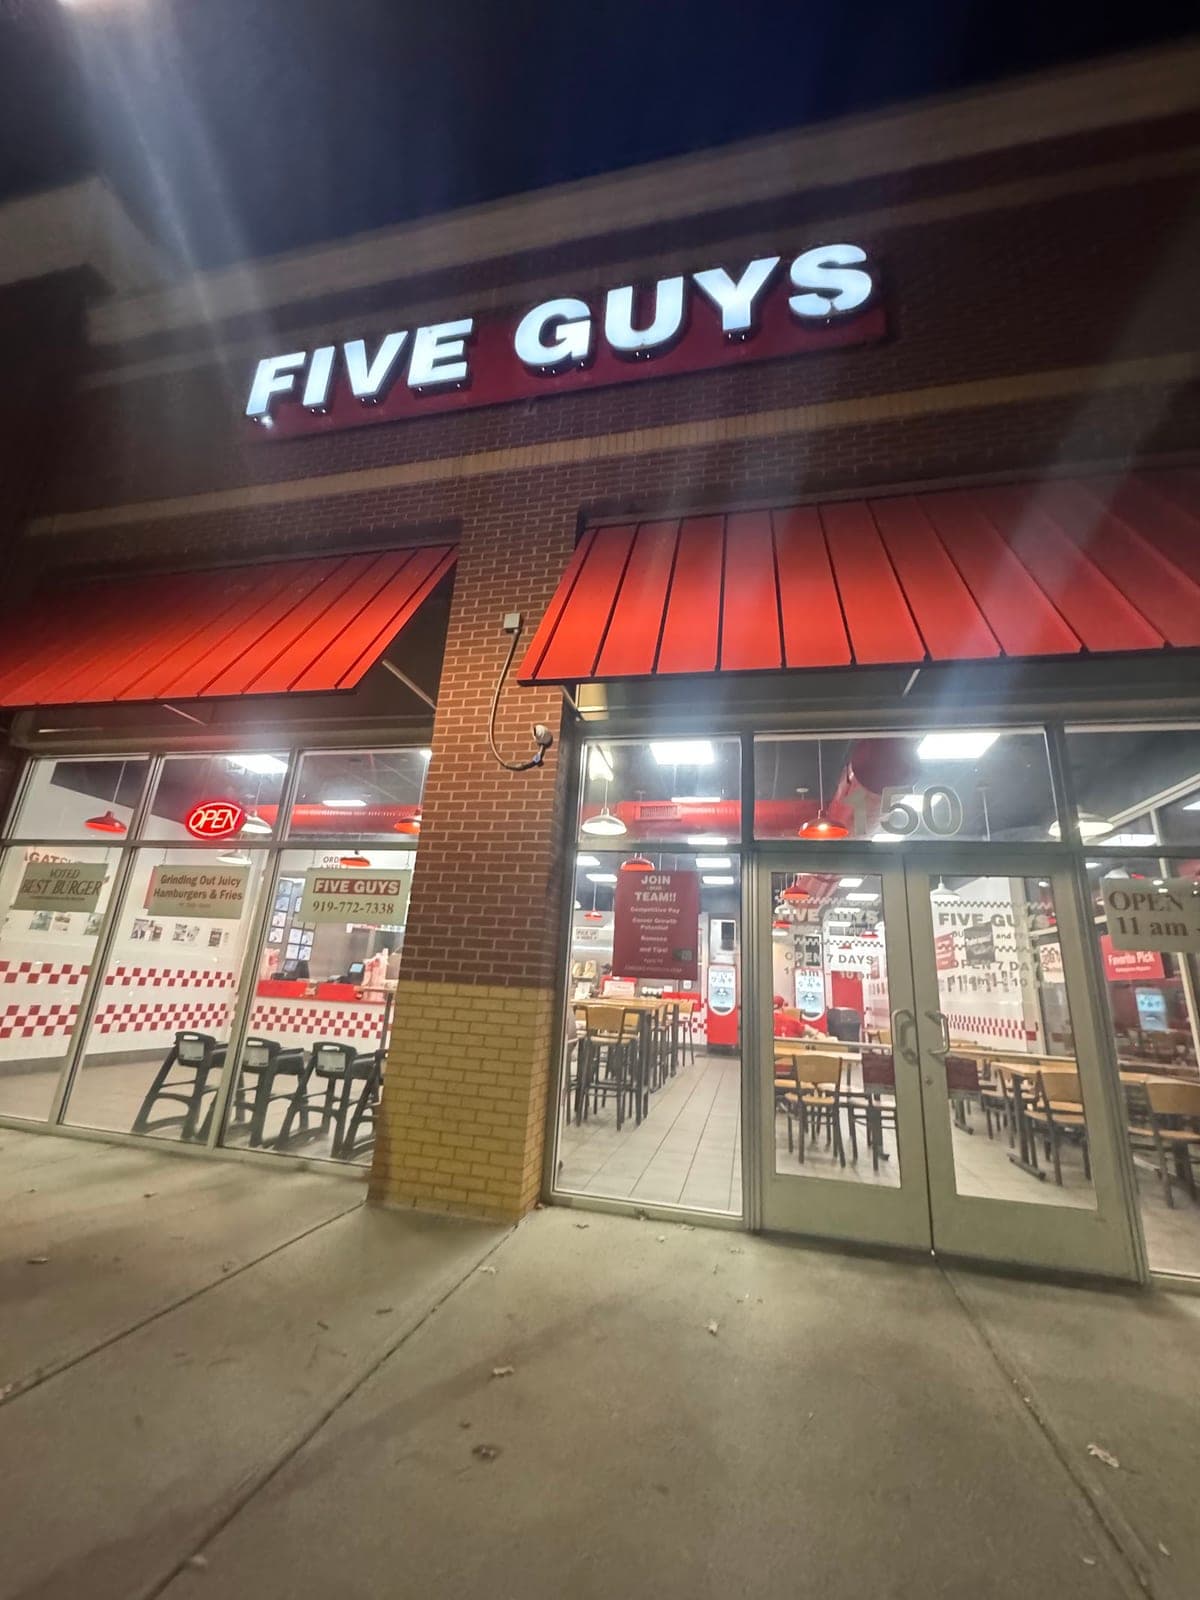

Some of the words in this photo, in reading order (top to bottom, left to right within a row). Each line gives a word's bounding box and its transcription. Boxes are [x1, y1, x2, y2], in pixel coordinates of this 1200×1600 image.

[246, 318, 473, 417] FIVE
[514, 243, 873, 367] GUYS
[189, 809, 234, 829] OPEN
[49, 868, 81, 879] VOTED
[641, 875, 670, 885] JOIN
[22, 879, 52, 894] BEST
[52, 879, 102, 896] BURGER
[160, 874, 198, 887] Grinding
[199, 875, 216, 885] Out
[217, 875, 241, 888] Juicy
[314, 879, 350, 893] FIVE
[353, 880, 399, 894] GUYS
[153, 888, 207, 901] Hamburgers
[208, 889, 218, 900] &
[219, 889, 243, 901] Fries
[634, 891, 677, 902] TEAM!!
[1109, 890, 1184, 912] OPEN
[312, 900, 395, 914] 919-772-7338
[938, 912, 984, 926] FIVE
[1117, 917, 1140, 935] 11
[1150, 921, 1188, 936] am
[785, 951, 822, 963] OPEN
[827, 953, 834, 963] 7
[838, 954, 875, 965] DAYS
